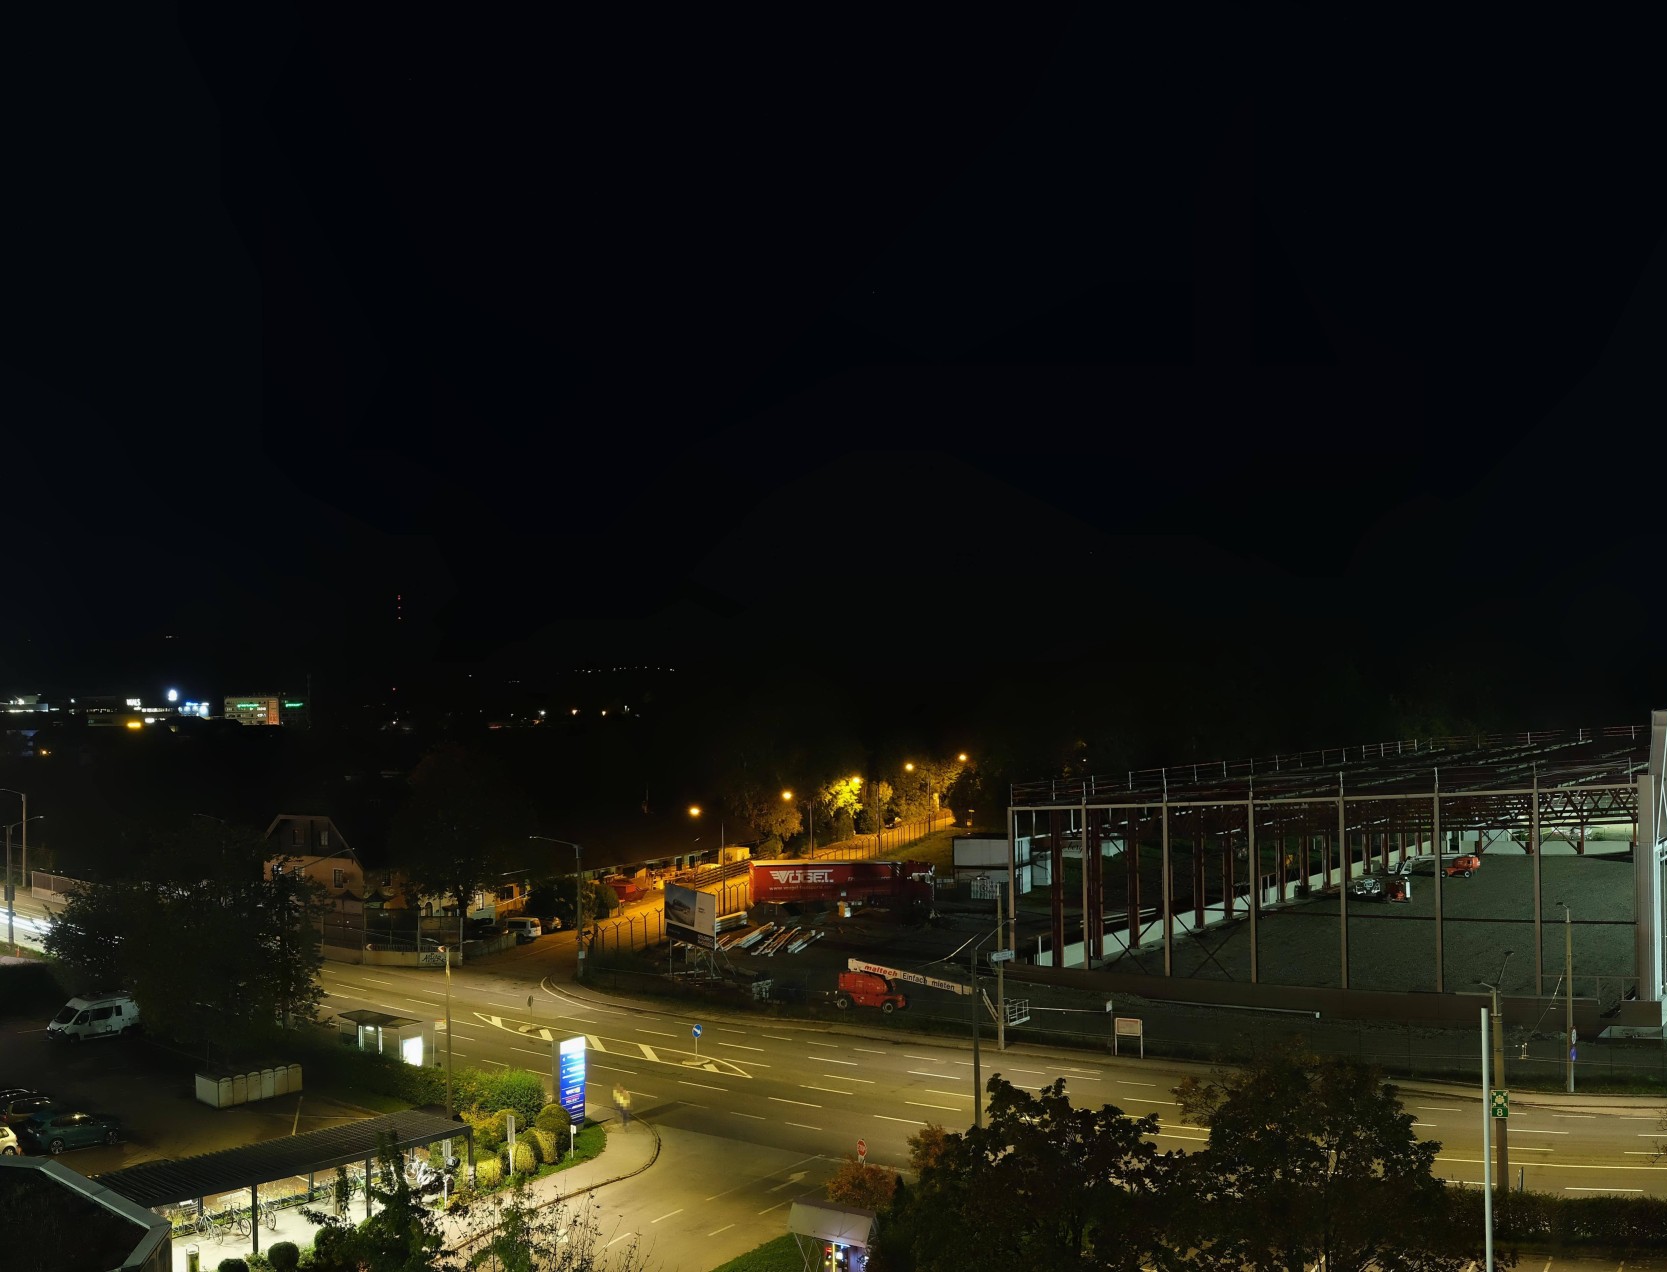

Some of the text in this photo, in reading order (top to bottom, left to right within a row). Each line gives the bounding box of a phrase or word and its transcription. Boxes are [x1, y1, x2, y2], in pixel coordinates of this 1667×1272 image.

[864, 964, 955, 991] maltech Einfach mieten
[1496, 1108, 1503, 1117] 8
